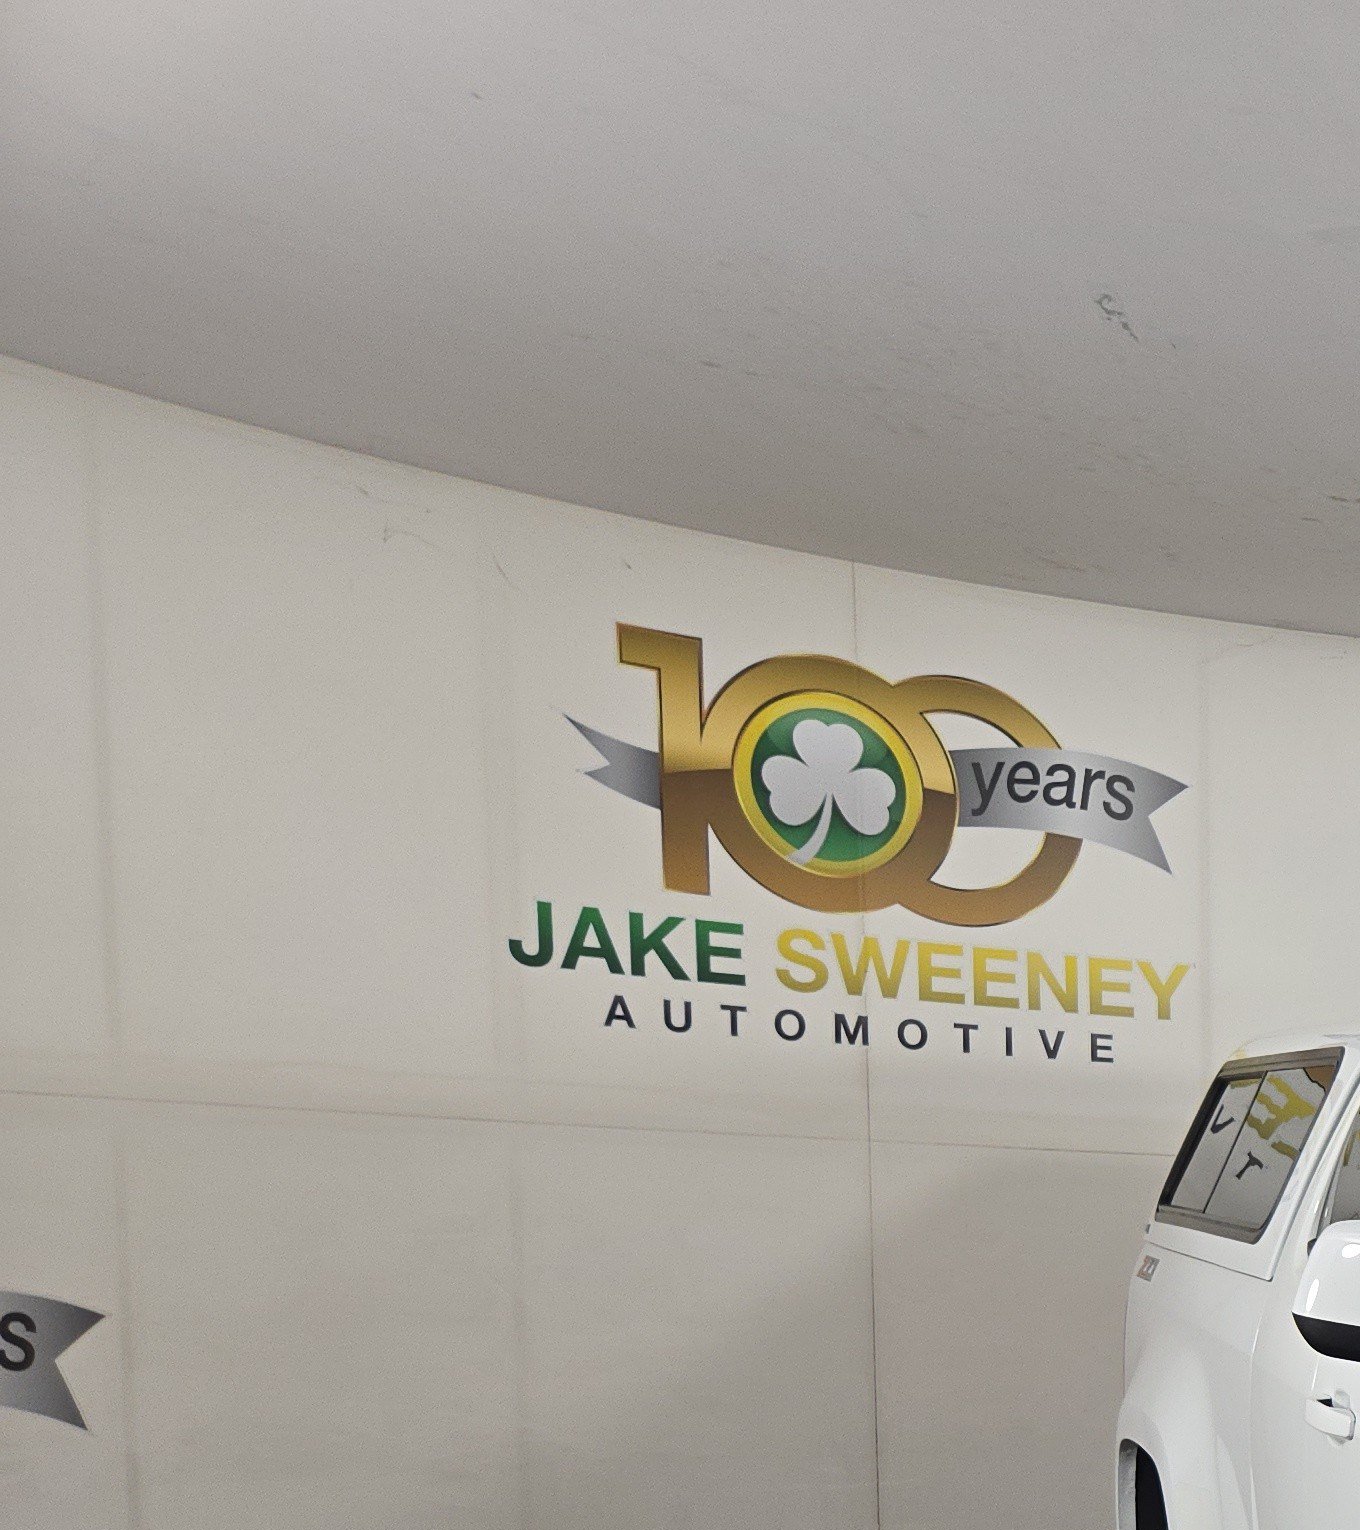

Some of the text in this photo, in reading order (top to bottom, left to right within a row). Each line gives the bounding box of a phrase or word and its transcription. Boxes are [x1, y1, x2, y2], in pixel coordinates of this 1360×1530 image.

[616, 622, 1136, 926] 100 years
[508, 901, 1190, 1021] JAKE SWEENEY
[604, 995, 1116, 1064] AUTOMOTIVE
